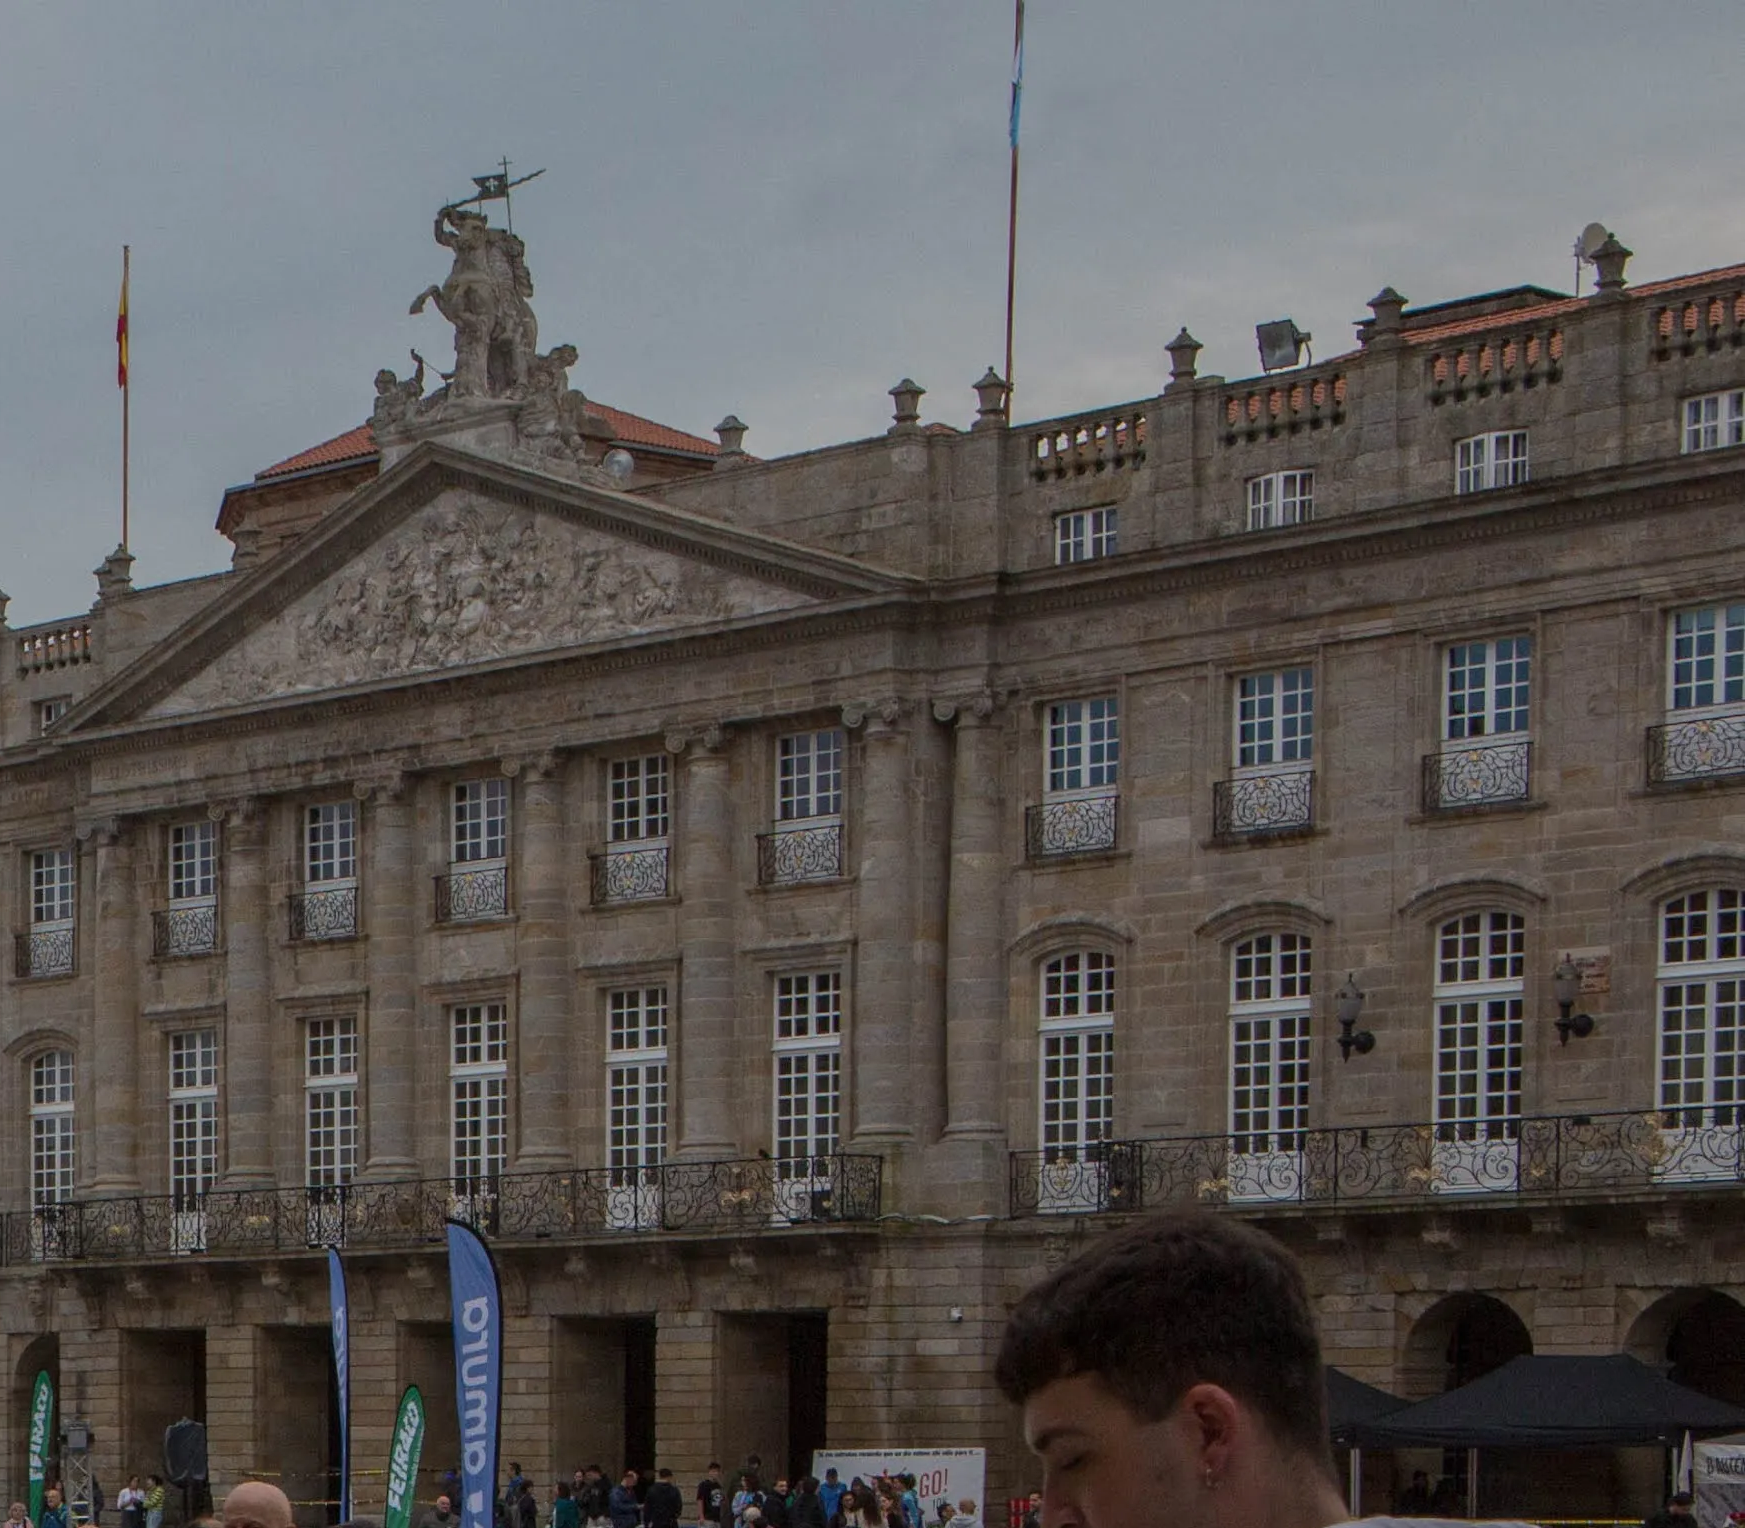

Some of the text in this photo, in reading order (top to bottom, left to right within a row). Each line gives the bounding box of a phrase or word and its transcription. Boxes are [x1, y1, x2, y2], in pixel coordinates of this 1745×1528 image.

[461, 1296, 489, 1476] amura
[389, 1401, 422, 1511] FEIRACO
[919, 1468, 949, 1498] GO!
